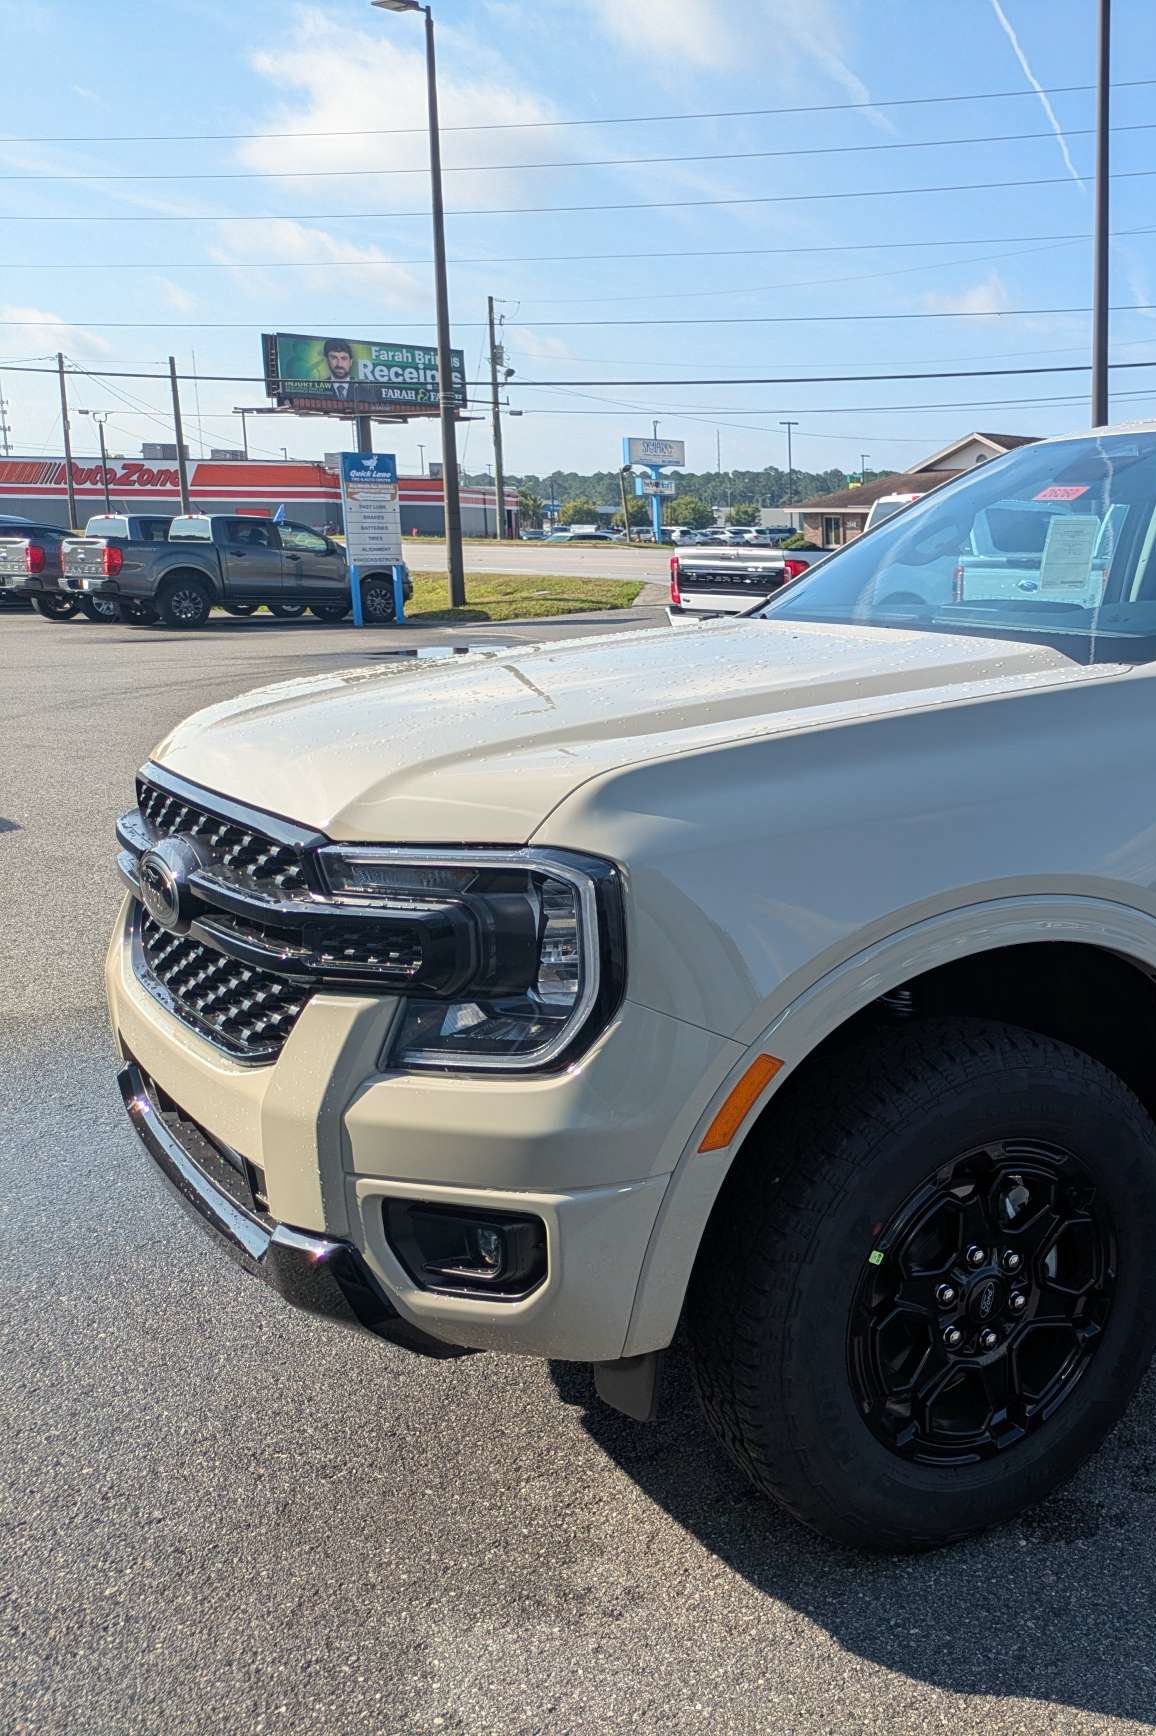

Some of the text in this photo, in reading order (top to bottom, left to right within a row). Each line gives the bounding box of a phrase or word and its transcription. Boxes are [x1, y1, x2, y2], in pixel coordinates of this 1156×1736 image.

[371, 346, 460, 367] Farah Bris
[357, 359, 463, 389] Receips
[315, 381, 332, 389] LAW
[382, 388, 415, 400] FARAH
[54, 462, 181, 487] AutoZone
[350, 469, 391, 478] Quick Lane
